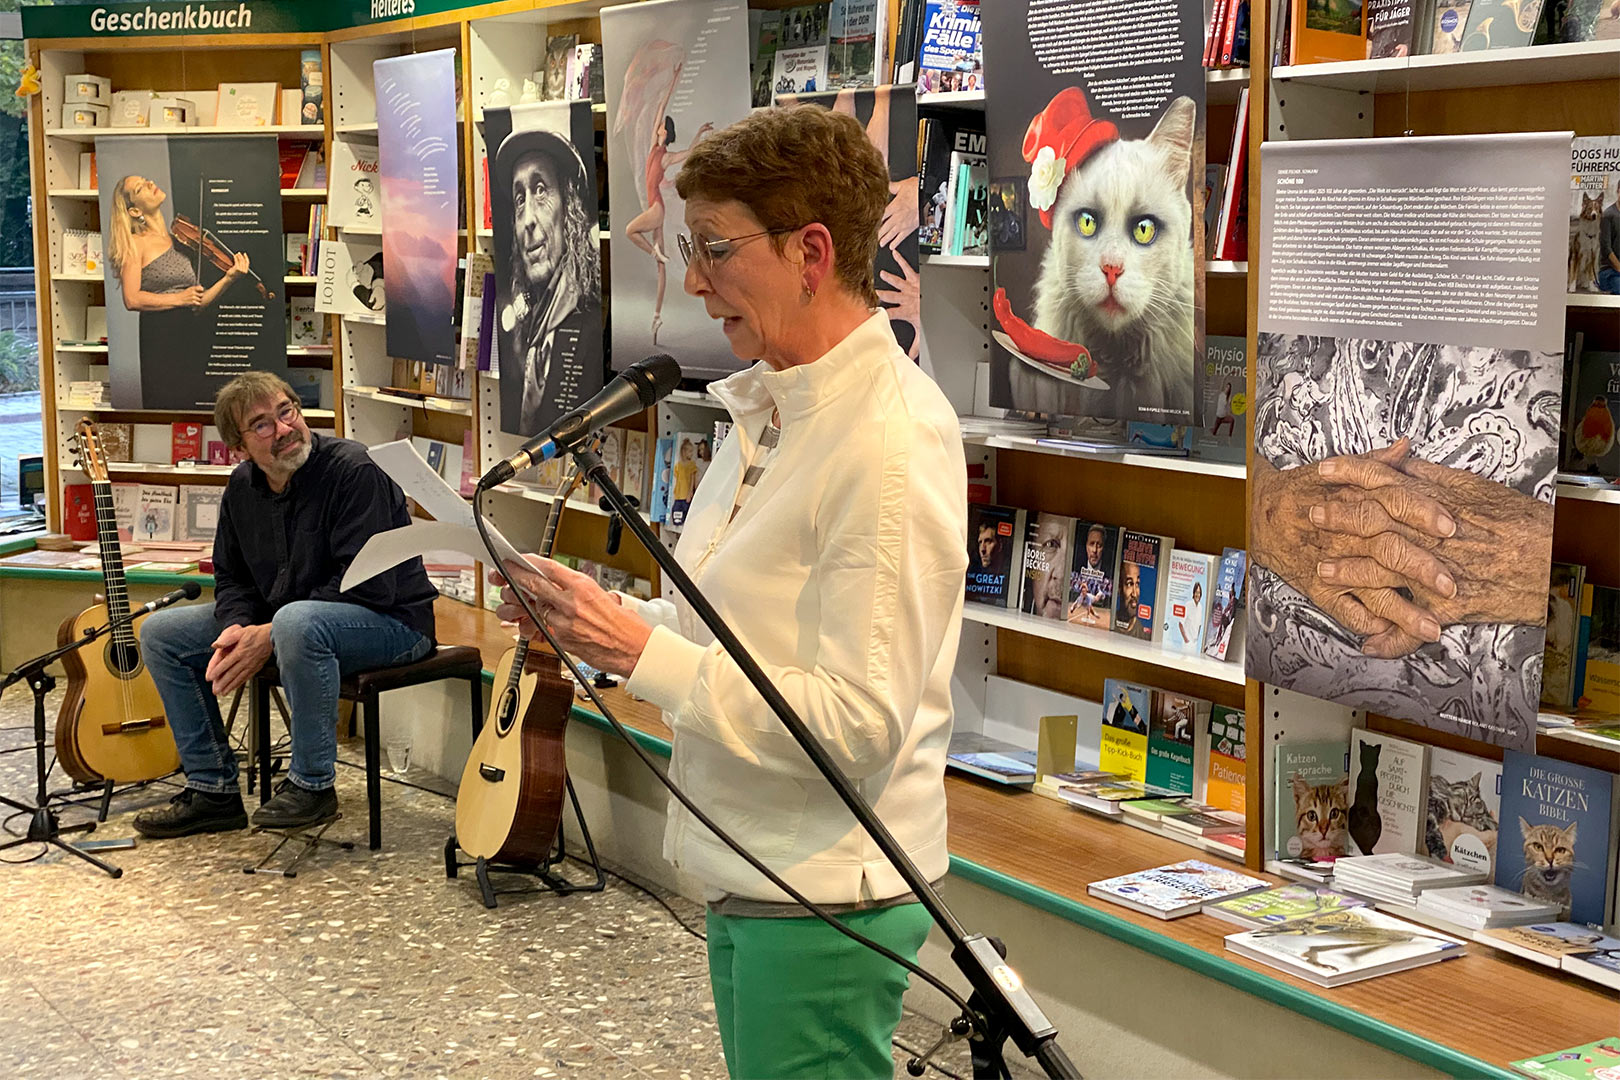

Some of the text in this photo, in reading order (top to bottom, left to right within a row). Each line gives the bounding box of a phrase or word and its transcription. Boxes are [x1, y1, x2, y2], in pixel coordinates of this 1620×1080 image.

[371, 0, 415, 18] Heiteres
[961, 4, 974, 13] Die
[1376, 6, 1410, 22] FÜR JÄGER
[91, 3, 252, 31] Geschenkbuch
[924, 28, 974, 48] Fälle
[939, 46, 967, 56] Sports
[1572, 149, 1602, 160] DOGS
[351, 160, 378, 173] Nick
[322, 248, 336, 305] LORIOT
[1208, 347, 1244, 363] Physio
[1206, 362, 1247, 377] @Home
[1026, 549, 1046, 560] BORIS
[1026, 560, 1050, 572] BECKER
[1172, 561, 1204, 575] BEWEGUNG
[976, 573, 1005, 585] GREAT
[966, 584, 1002, 594] NOWITZKI
[1105, 733, 1131, 747] Das große
[1104, 744, 1142, 762] Tipp-Kick-Buch
[1286, 754, 1316, 764] Katzen
[1213, 762, 1246, 786] Patience
[1298, 764, 1332, 778] sprache
[1530, 767, 1586, 790] DIE GROSSE
[1522, 779, 1589, 812] KATZEN
[1379, 796, 1416, 814] GESCHICHTE
[1539, 804, 1570, 822] BIBEL
[1454, 844, 1487, 862] Kätzchen
[1140, 874, 1209, 898] HERRSCHER
[1156, 874, 1218, 895] HEIMLICHE
